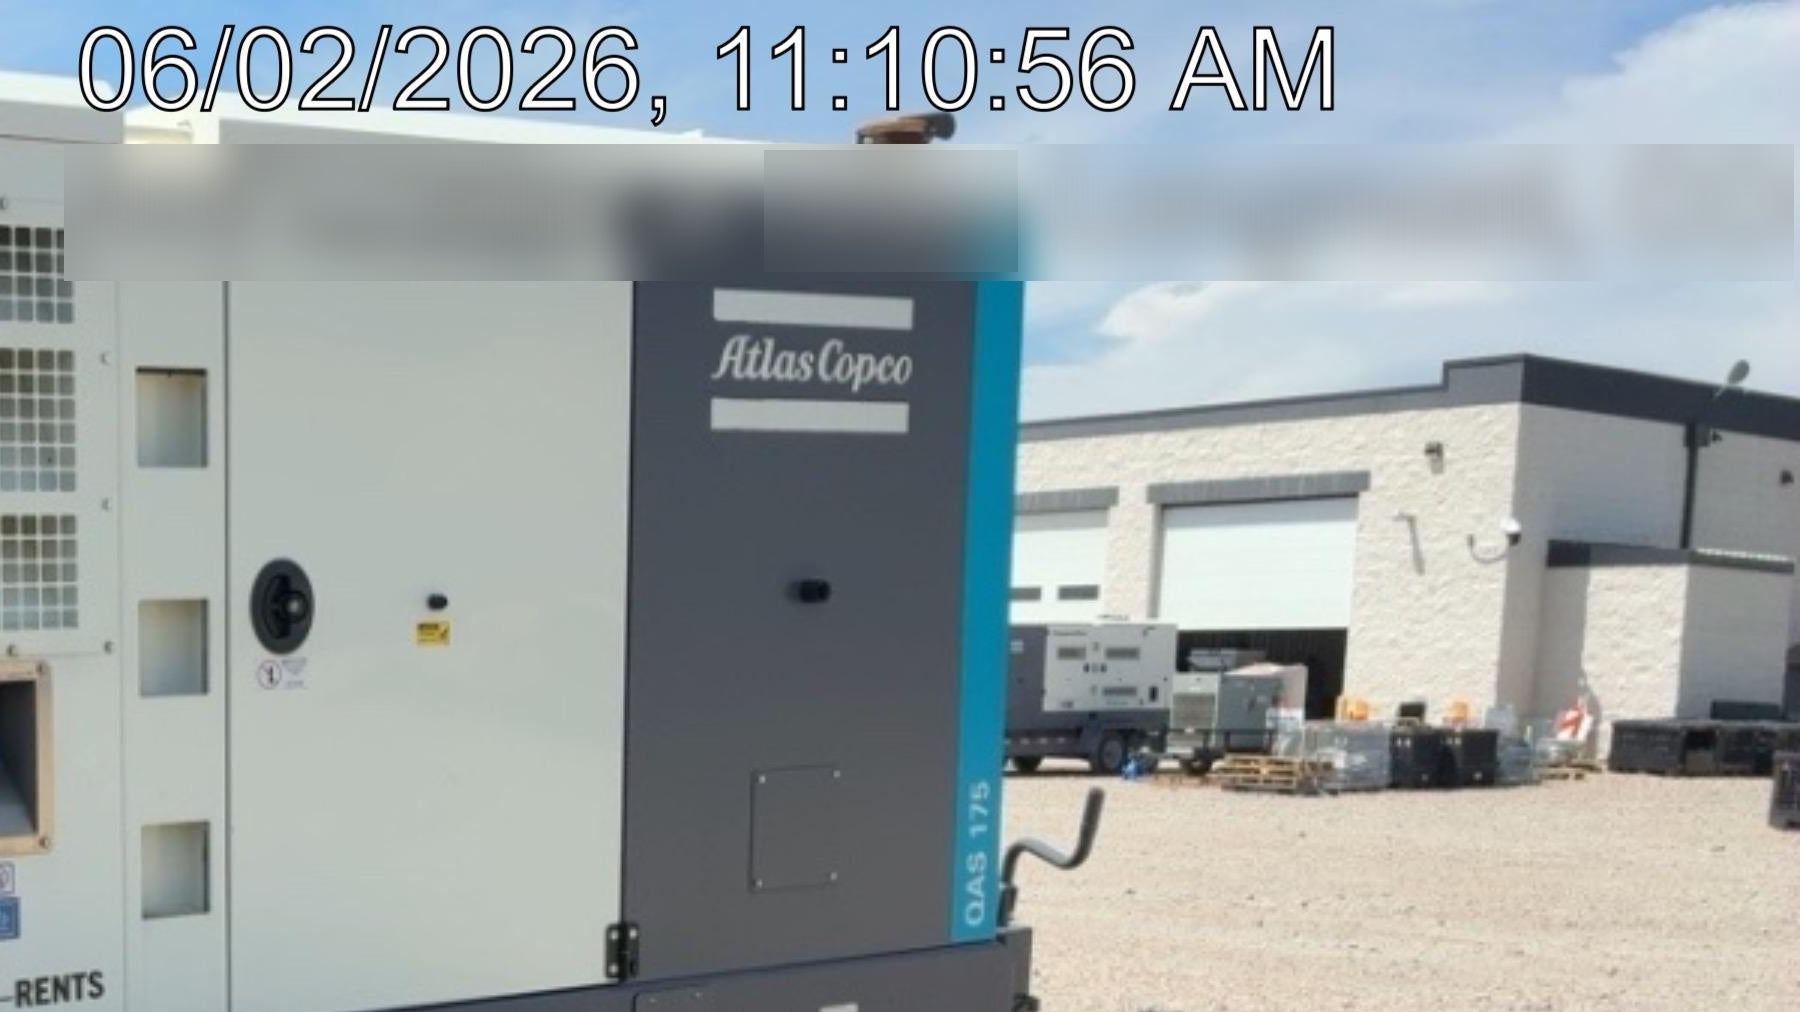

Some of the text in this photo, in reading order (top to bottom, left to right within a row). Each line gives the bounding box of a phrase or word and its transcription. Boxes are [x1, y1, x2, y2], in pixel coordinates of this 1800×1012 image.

[711, 334, 913, 393] Atlas Copco
[965, 780, 991, 927] QAS 175
